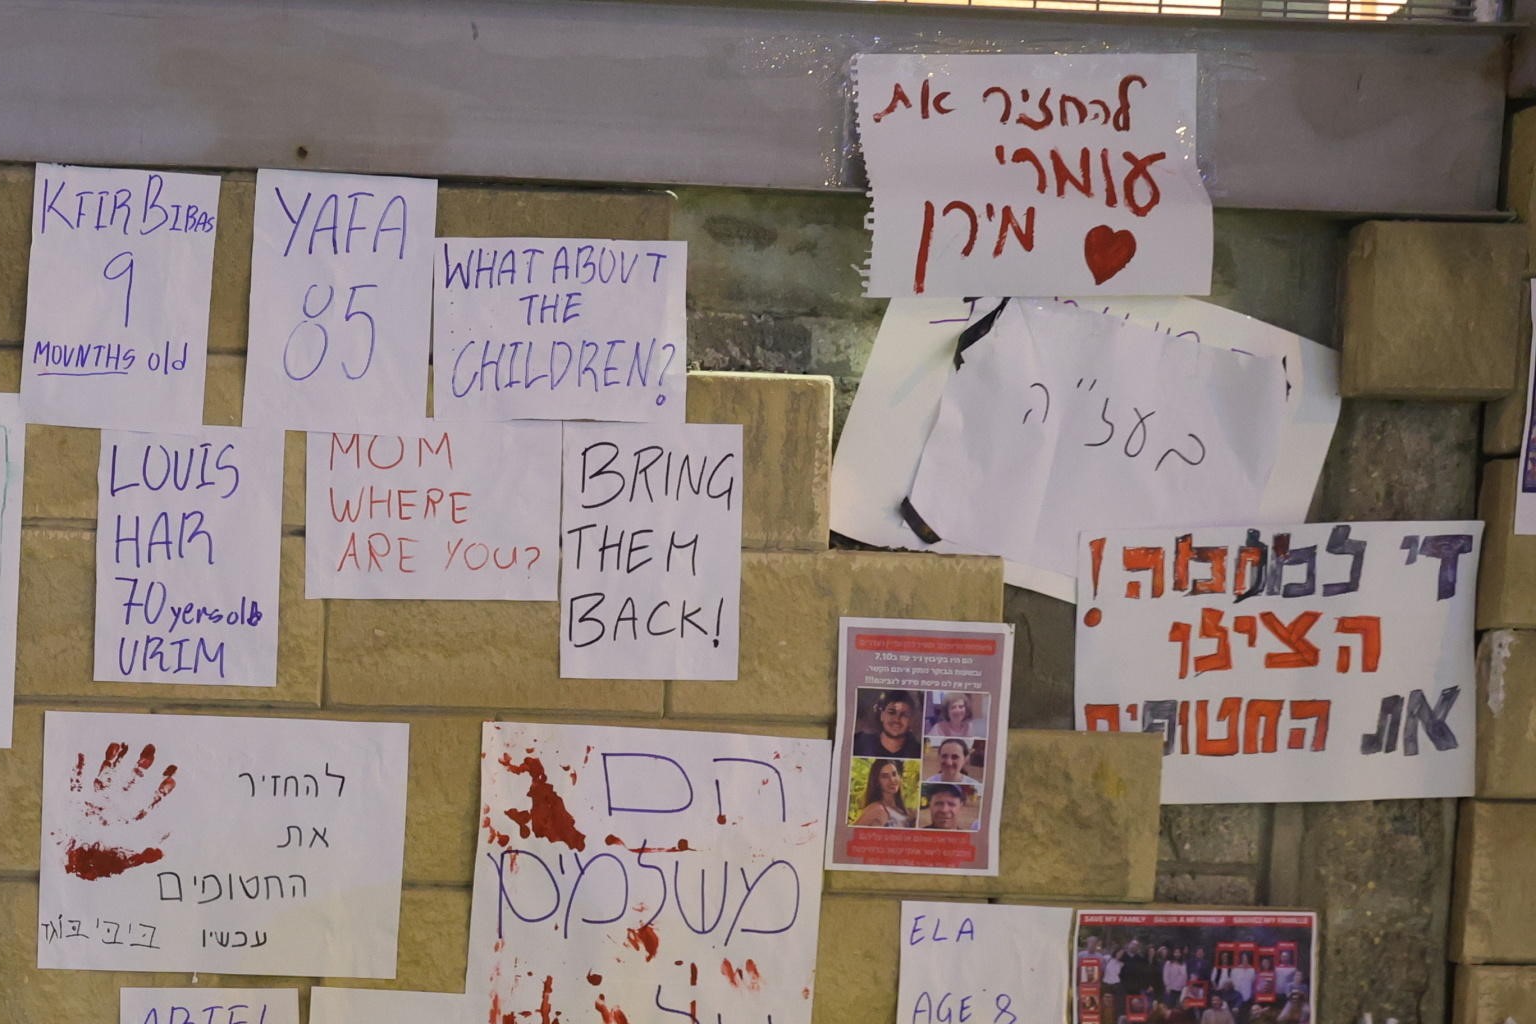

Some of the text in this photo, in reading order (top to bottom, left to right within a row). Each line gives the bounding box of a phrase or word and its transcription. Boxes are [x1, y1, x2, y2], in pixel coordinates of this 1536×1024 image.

[872, 74, 1147, 132] להחזיר את
[41, 179, 130, 236] KFIR
[994, 144, 1166, 217] עומרי
[274, 186, 407, 260] YAFA
[912, 200, 1036, 294] מירן
[103, 251, 135, 328] 9
[444, 243, 667, 290] WHAT ABOUT
[282, 284, 378, 381] 85
[519, 292, 582, 326] THE
[147, 342, 187, 373] old
[451, 337, 676, 407] CHILDREN?
[109, 443, 239, 499] LOUIS
[329, 432, 453, 471] MOM
[581, 442, 735, 511] BRING
[329, 486, 472, 524] WHERE
[114, 511, 214, 565] HAR
[337, 532, 541, 580] ARE YOU?
[567, 524, 700, 577] THEM
[1400, 534, 1473, 601] די
[115, 577, 166, 625] 70
[568, 592, 724, 648] BACK!
[119, 636, 225, 678] URIM
[1168, 607, 1381, 679] הצילו
[1361, 685, 1460, 756] את
[239, 764, 345, 798] להחזיר
[602, 753, 786, 822] הם
[277, 826, 329, 849] את
[158, 872, 307, 904] החטופים
[487, 839, 800, 946] משלמים
[201, 928, 267, 949] עכשיו
[909, 915, 974, 946] ELA
[912, 993, 973, 1024] AGE
